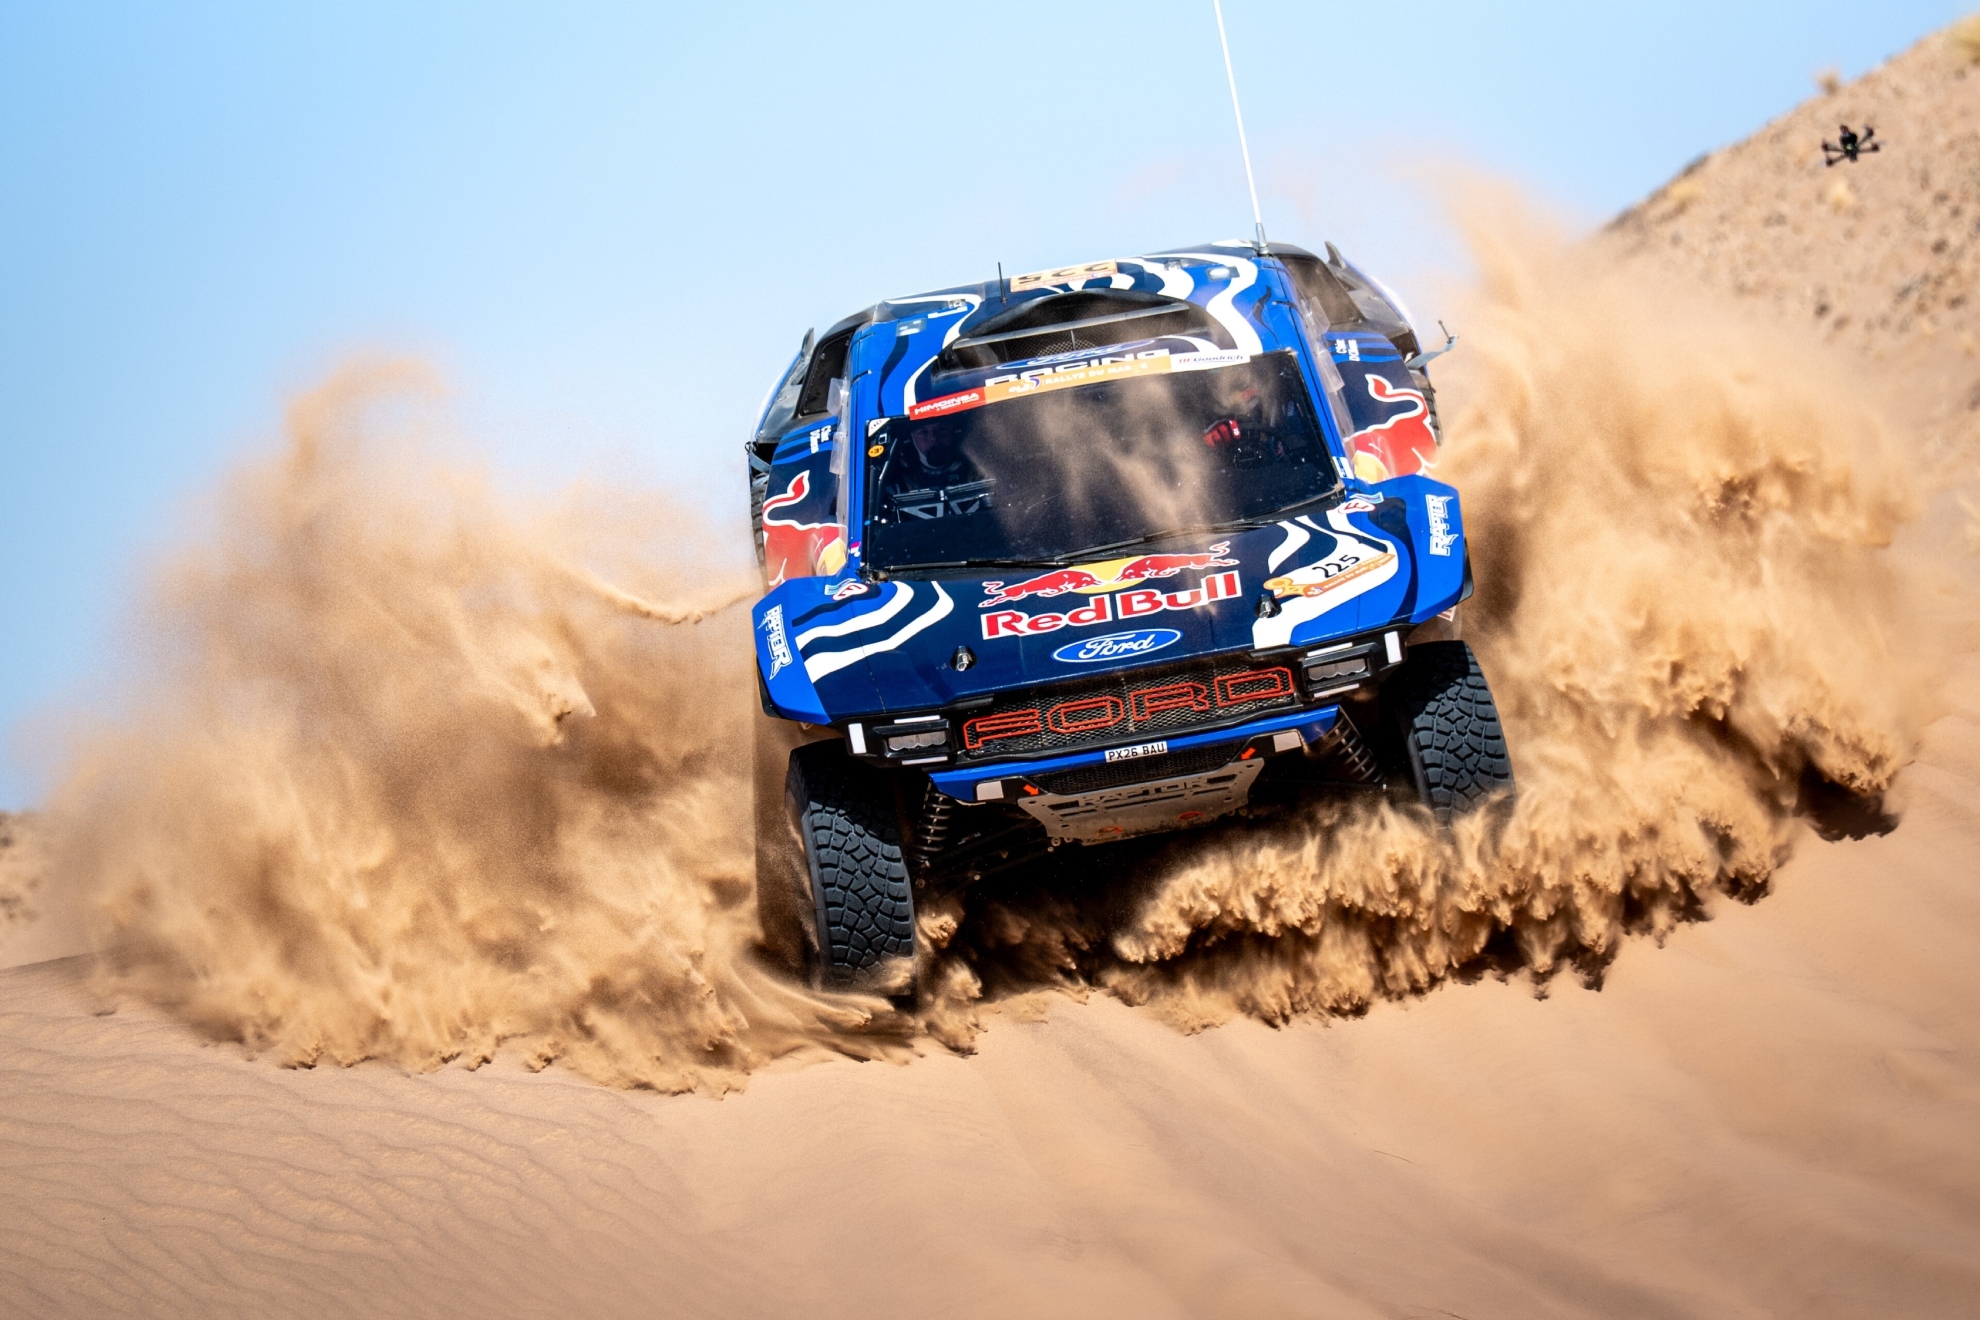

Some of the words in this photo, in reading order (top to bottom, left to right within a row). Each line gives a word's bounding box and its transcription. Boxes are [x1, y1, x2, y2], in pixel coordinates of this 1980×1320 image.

[1311, 554, 1360, 579] 225
[980, 594, 1113, 641] Red
[1116, 570, 1243, 620] Bull
[1077, 633, 1155, 660] Ford
[962, 666, 1295, 750] FORD
[1108, 748, 1139, 761] PX26
[1142, 742, 1165, 755] BAU
